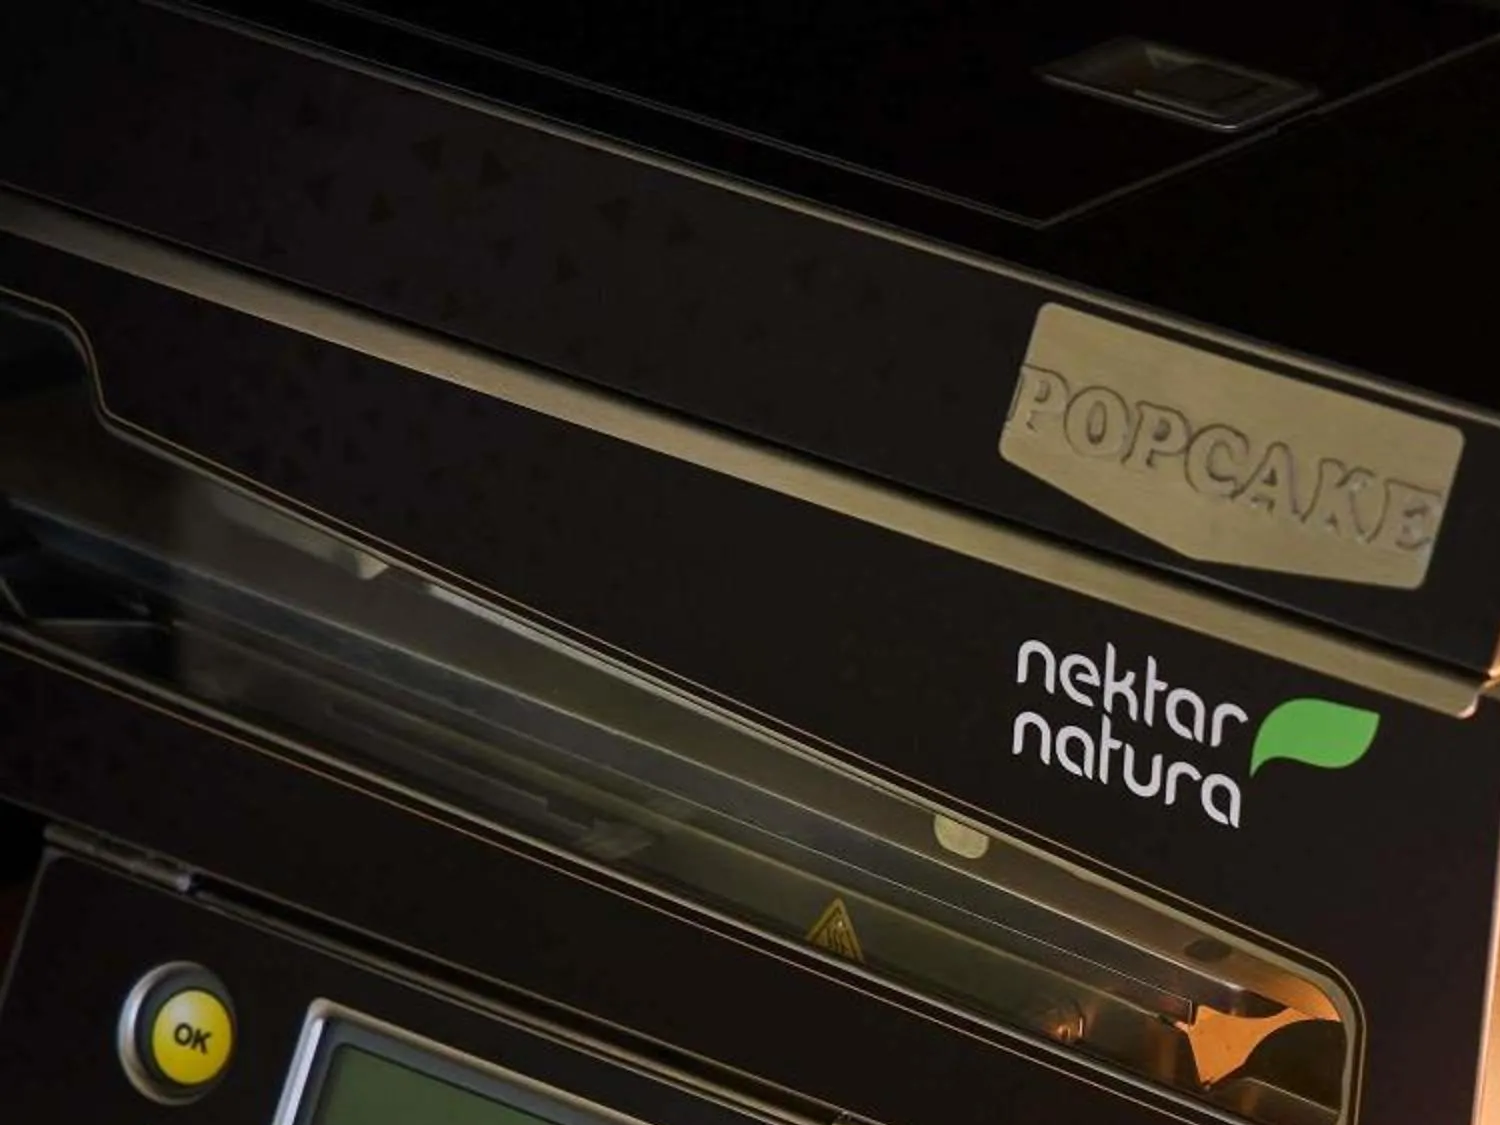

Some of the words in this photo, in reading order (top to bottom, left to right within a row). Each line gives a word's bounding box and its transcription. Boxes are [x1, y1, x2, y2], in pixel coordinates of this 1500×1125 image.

[1004, 362, 1443, 553] POPCAKE
[1016, 639, 1249, 748] nektar
[1012, 710, 1243, 829] natura
[173, 1022, 212, 1056] OK
